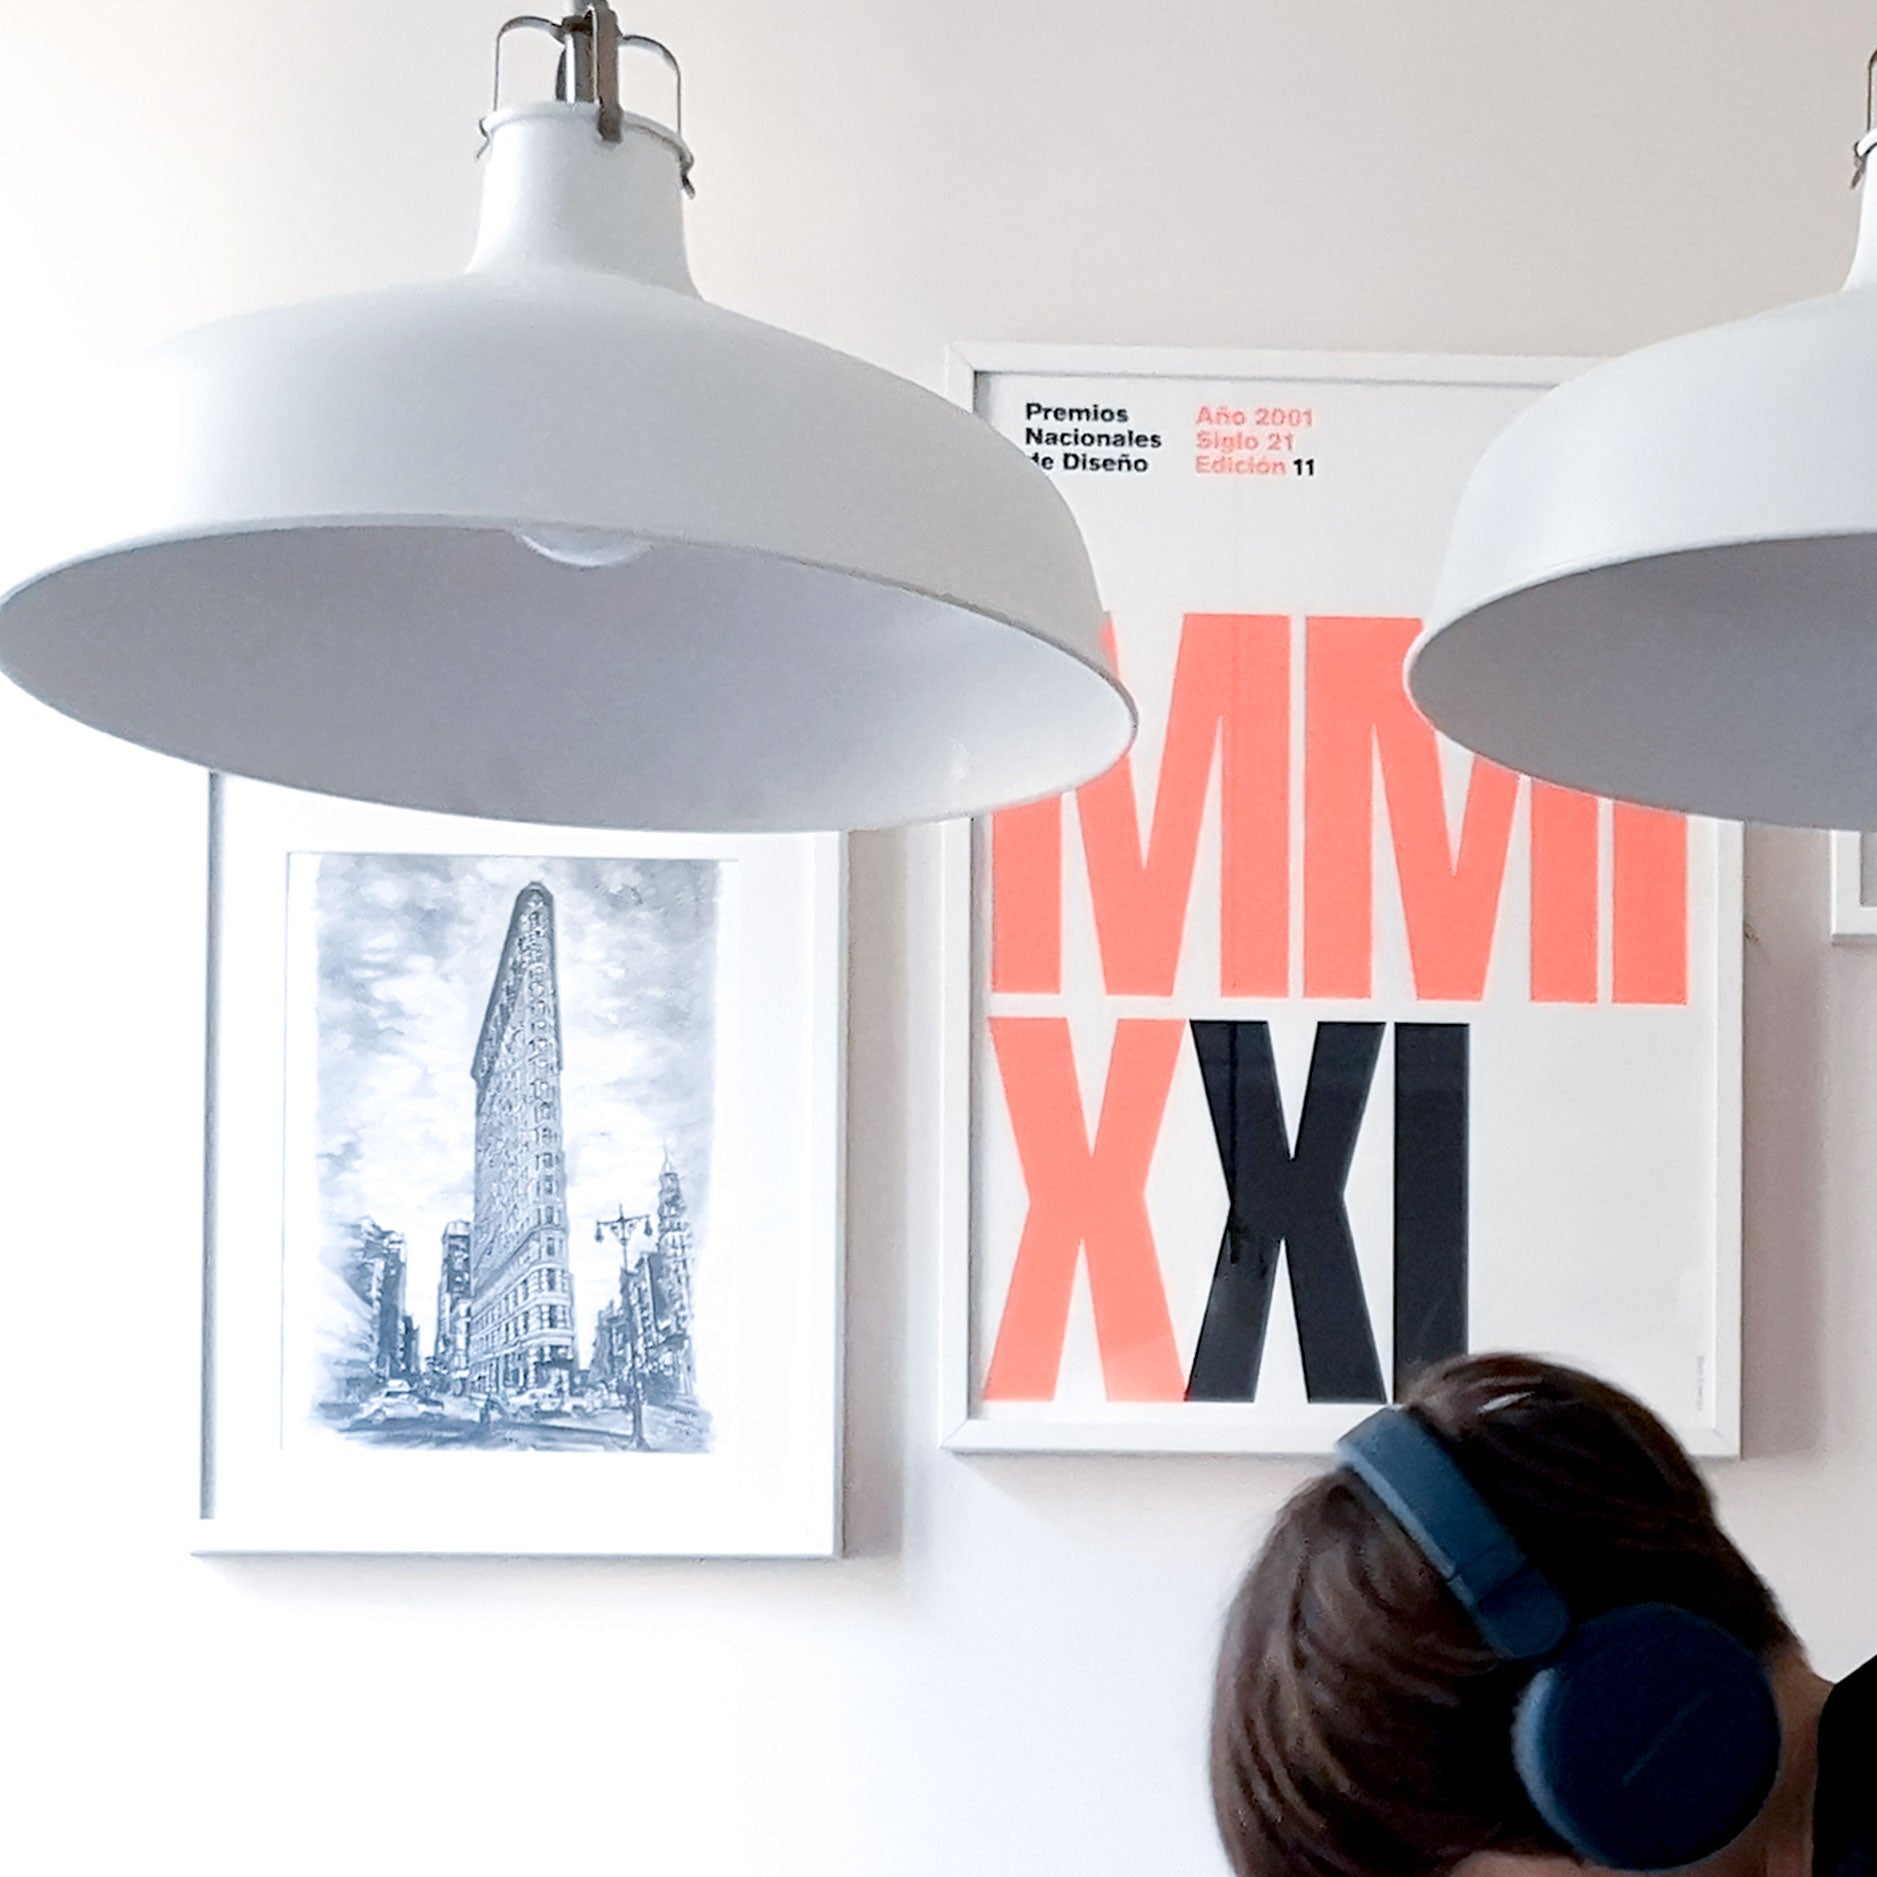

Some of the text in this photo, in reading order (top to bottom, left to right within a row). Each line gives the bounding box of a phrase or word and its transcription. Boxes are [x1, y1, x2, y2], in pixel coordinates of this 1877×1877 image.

[1025, 402, 1129, 423] Premios
[1196, 406, 1314, 427] Año 2001
[1025, 427, 1162, 448] Nacionales
[1196, 430, 1295, 454] Siglo 21
[1062, 452, 1149, 472] Diseño
[1195, 455, 1315, 476] Edición 11
[981, 1016, 1471, 1405] XXI
